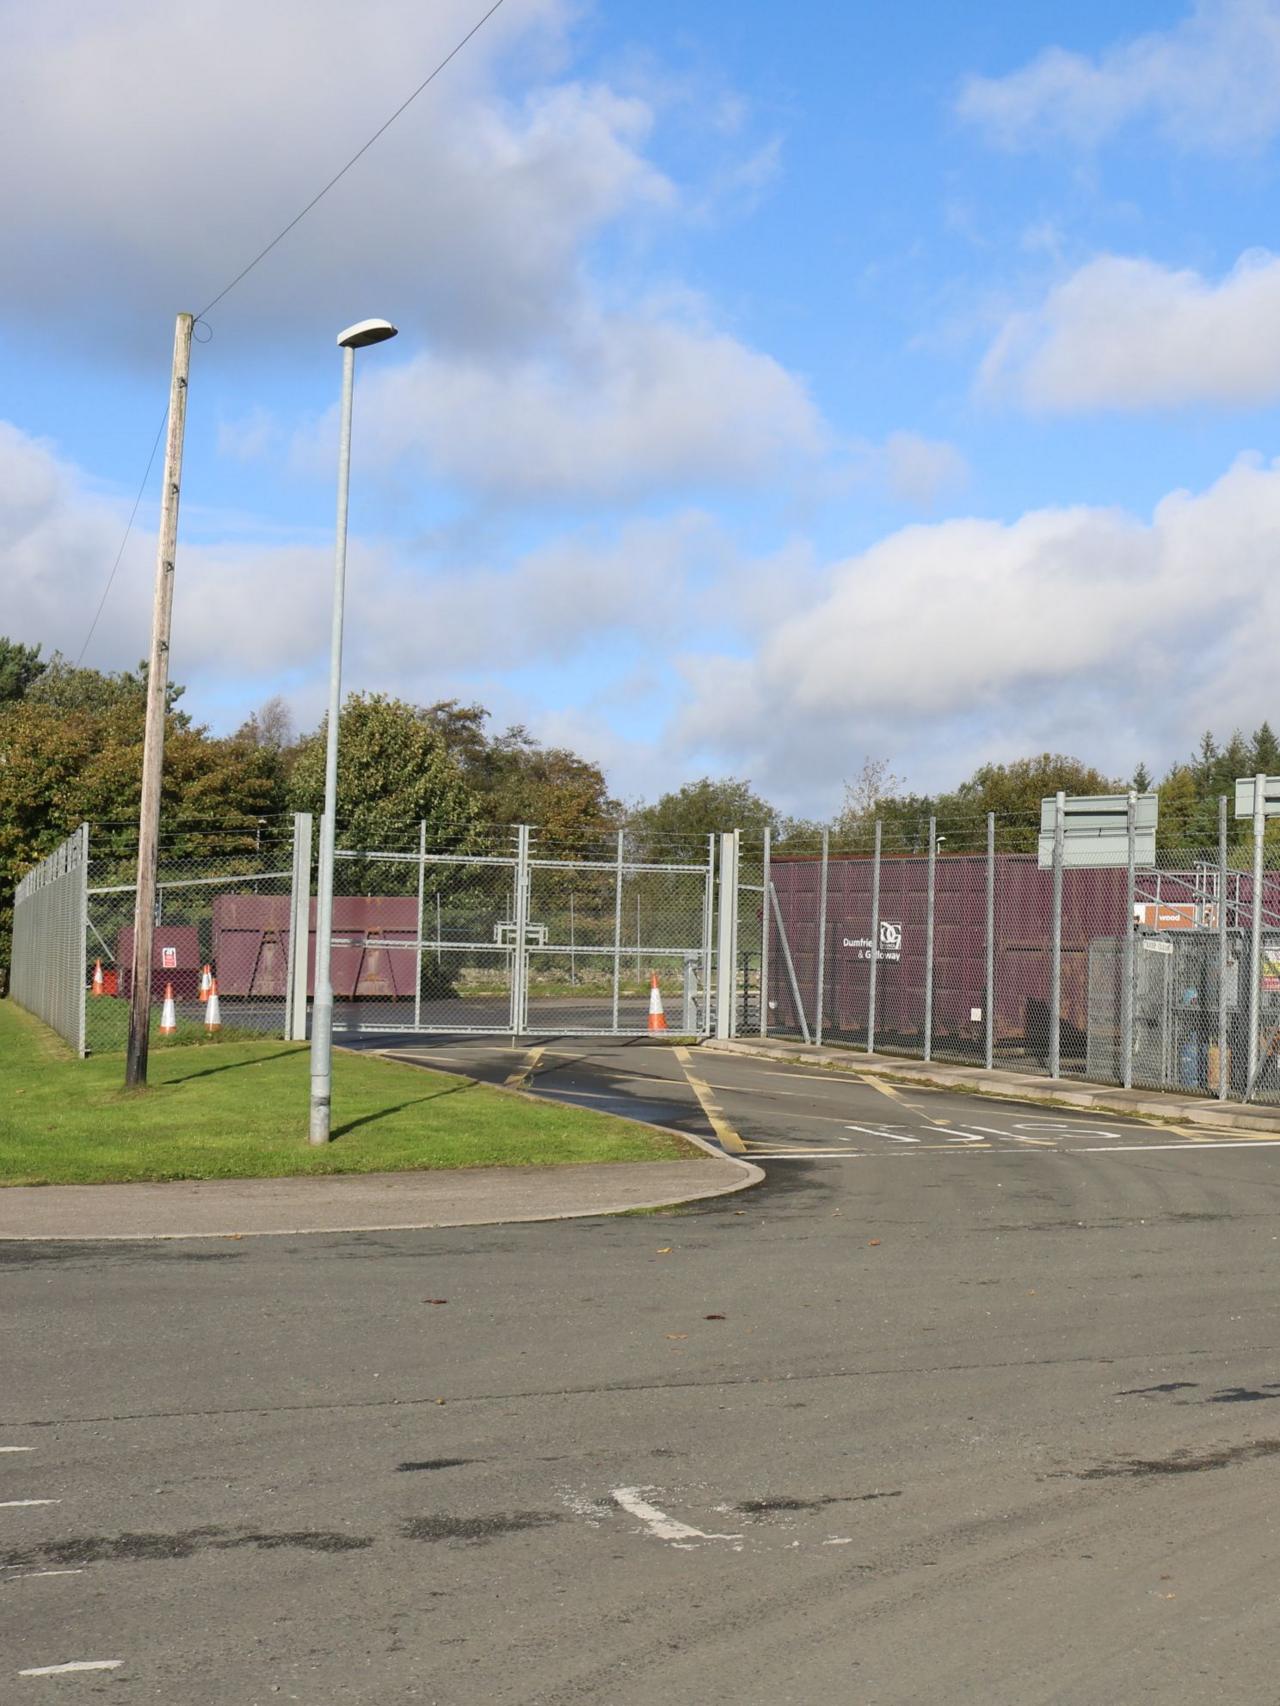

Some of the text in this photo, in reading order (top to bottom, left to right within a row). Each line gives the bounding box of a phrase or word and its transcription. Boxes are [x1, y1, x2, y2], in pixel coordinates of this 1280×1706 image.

[1159, 914, 1181, 922] wood
[843, 938, 873, 947] Dumfrie
[857, 950, 864, 959] &
